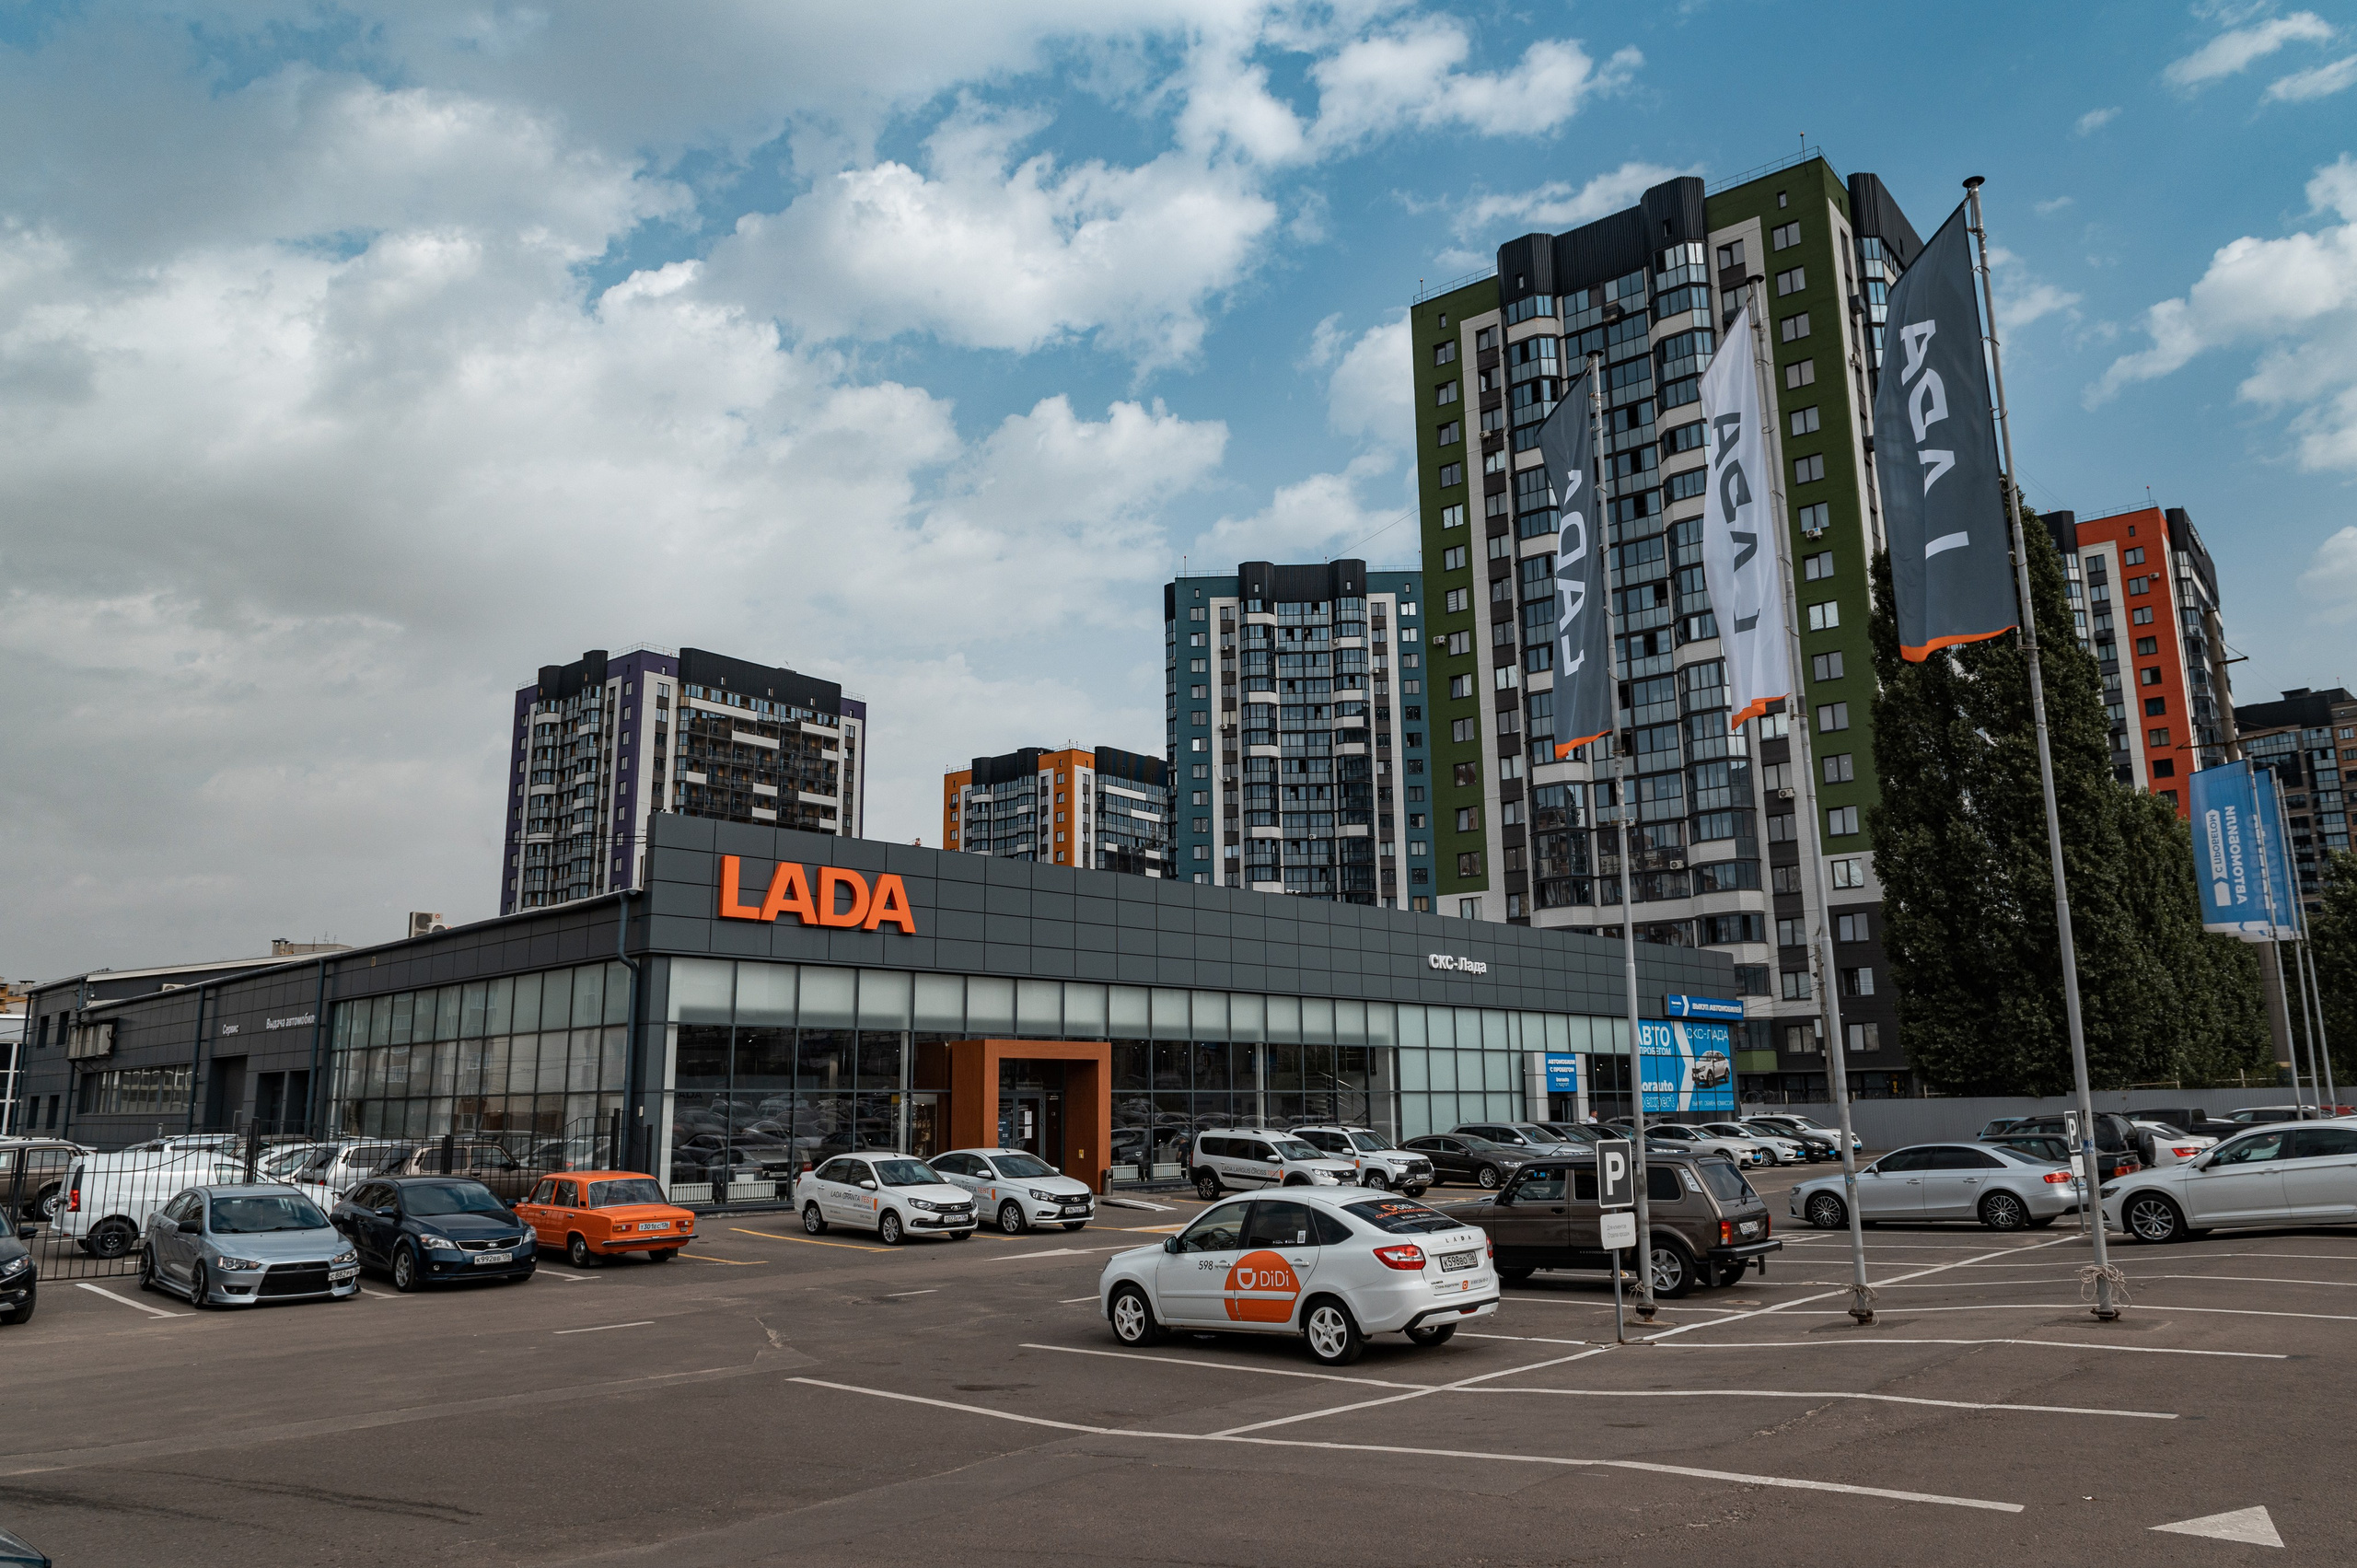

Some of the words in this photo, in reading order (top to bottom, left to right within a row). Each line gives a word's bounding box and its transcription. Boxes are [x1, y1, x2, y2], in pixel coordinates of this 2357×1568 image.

[718, 854, 916, 934] LADA
[1428, 953, 1487, 974] СКС-Лада
[266, 1017, 285, 1030] Выдача
[285, 1012, 316, 1027] автомобил
[1686, 1028, 1729, 1042] СКС-ЛАДА
[1642, 1079, 1674, 1092] orauto
[2068, 1119, 2077, 1145] P
[1251, 1167, 1267, 1176] CROSS
[1605, 1152, 1625, 1196] P
[861, 1195, 873, 1203] TEST
[1445, 1235, 1471, 1243] LADA
[1199, 1260, 1213, 1271] 598
[1443, 1256, 1468, 1268] К598ВО
[1467, 1253, 1476, 1261] 136
[1260, 1270, 1290, 1287] DiDi
